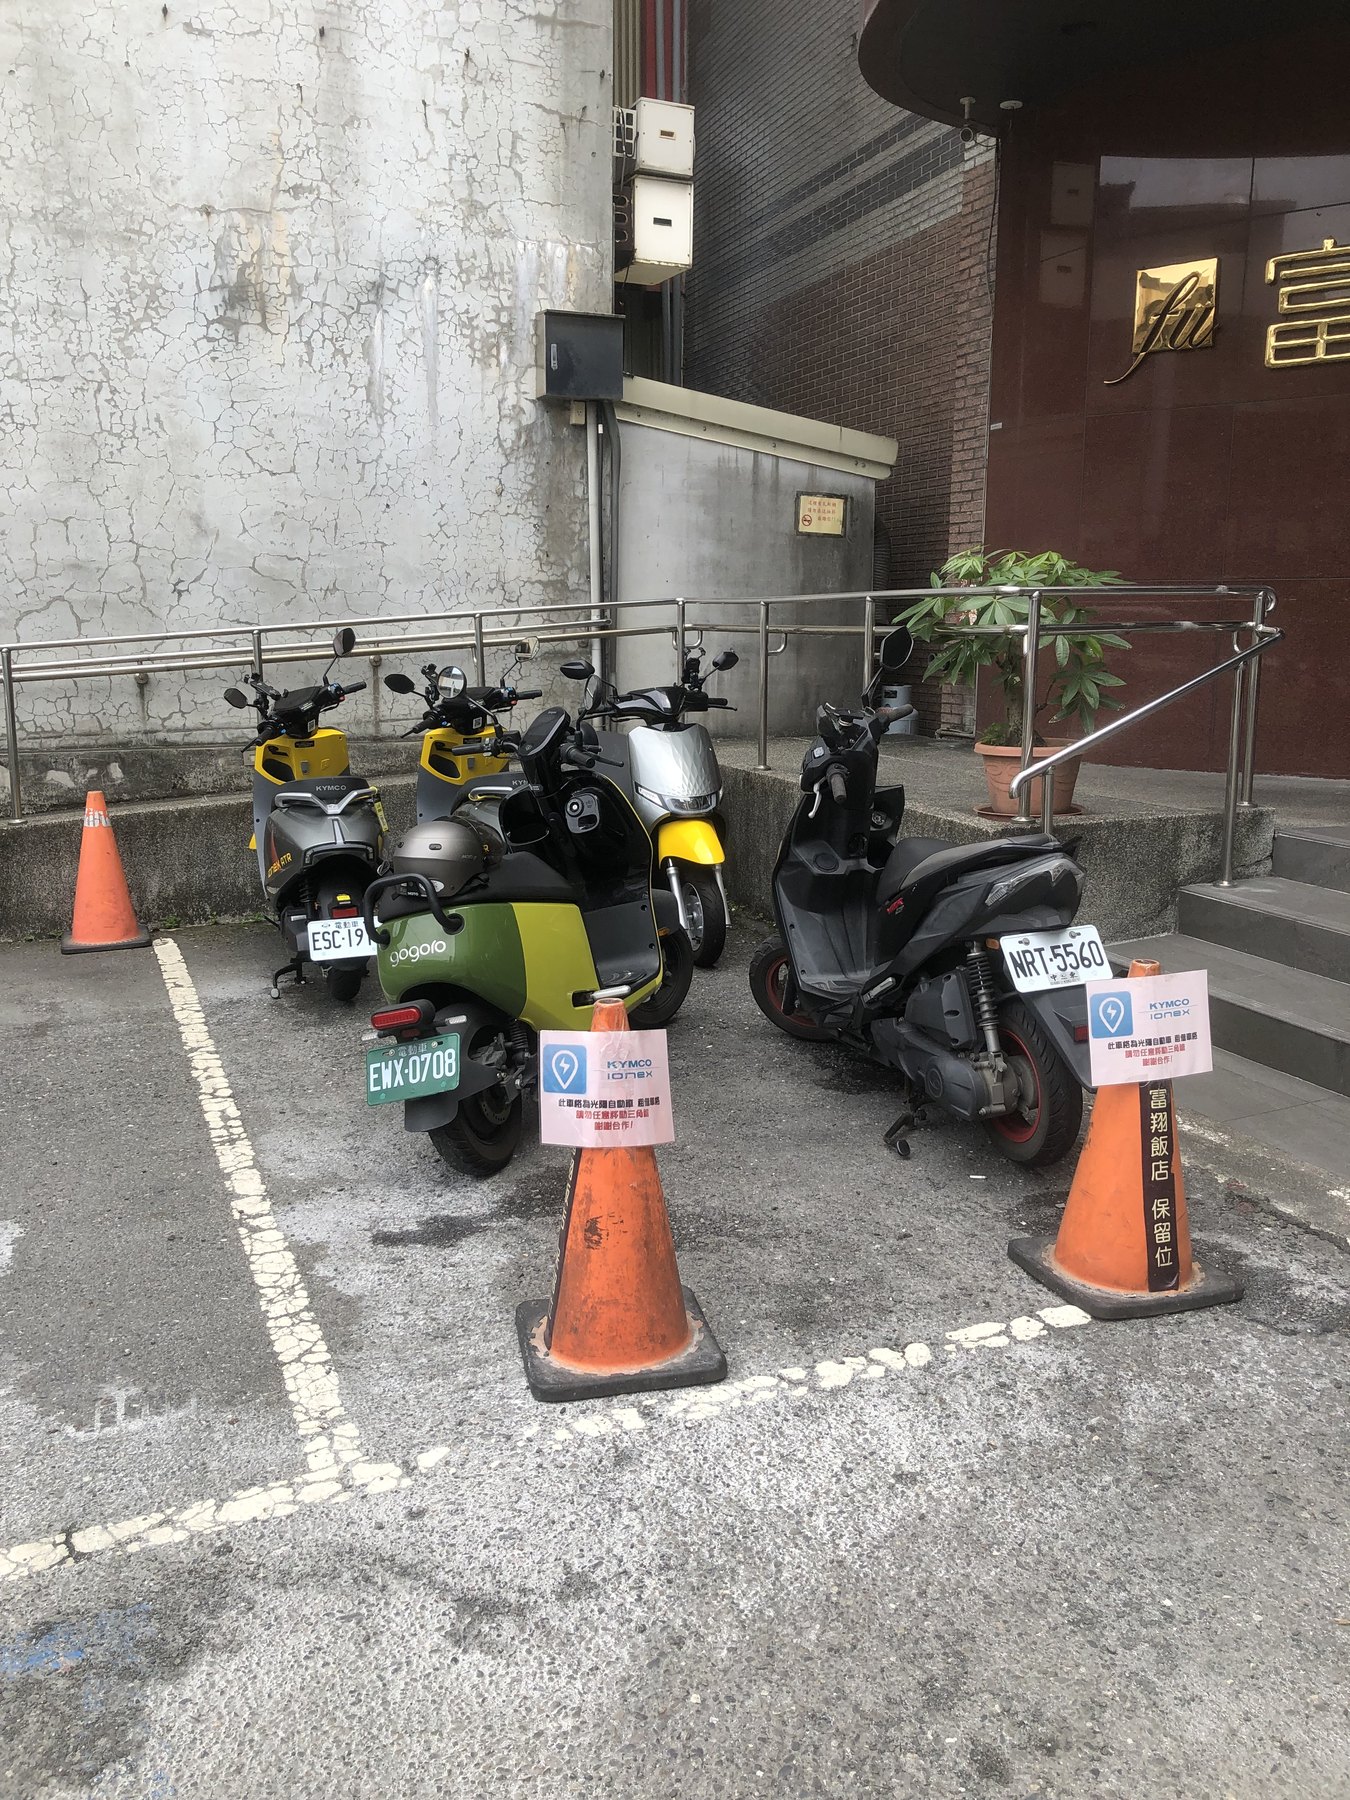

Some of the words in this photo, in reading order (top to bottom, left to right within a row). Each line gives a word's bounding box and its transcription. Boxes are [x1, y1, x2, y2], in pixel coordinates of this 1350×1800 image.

[389, 940, 447, 967] gogoro
[1149, 998, 1190, 1010] KYMCO
[607, 1059, 652, 1069] KYMCO
[1149, 1089, 1169, 1181] 富翔飯店
[1151, 1198, 1173, 1268] 保留位
